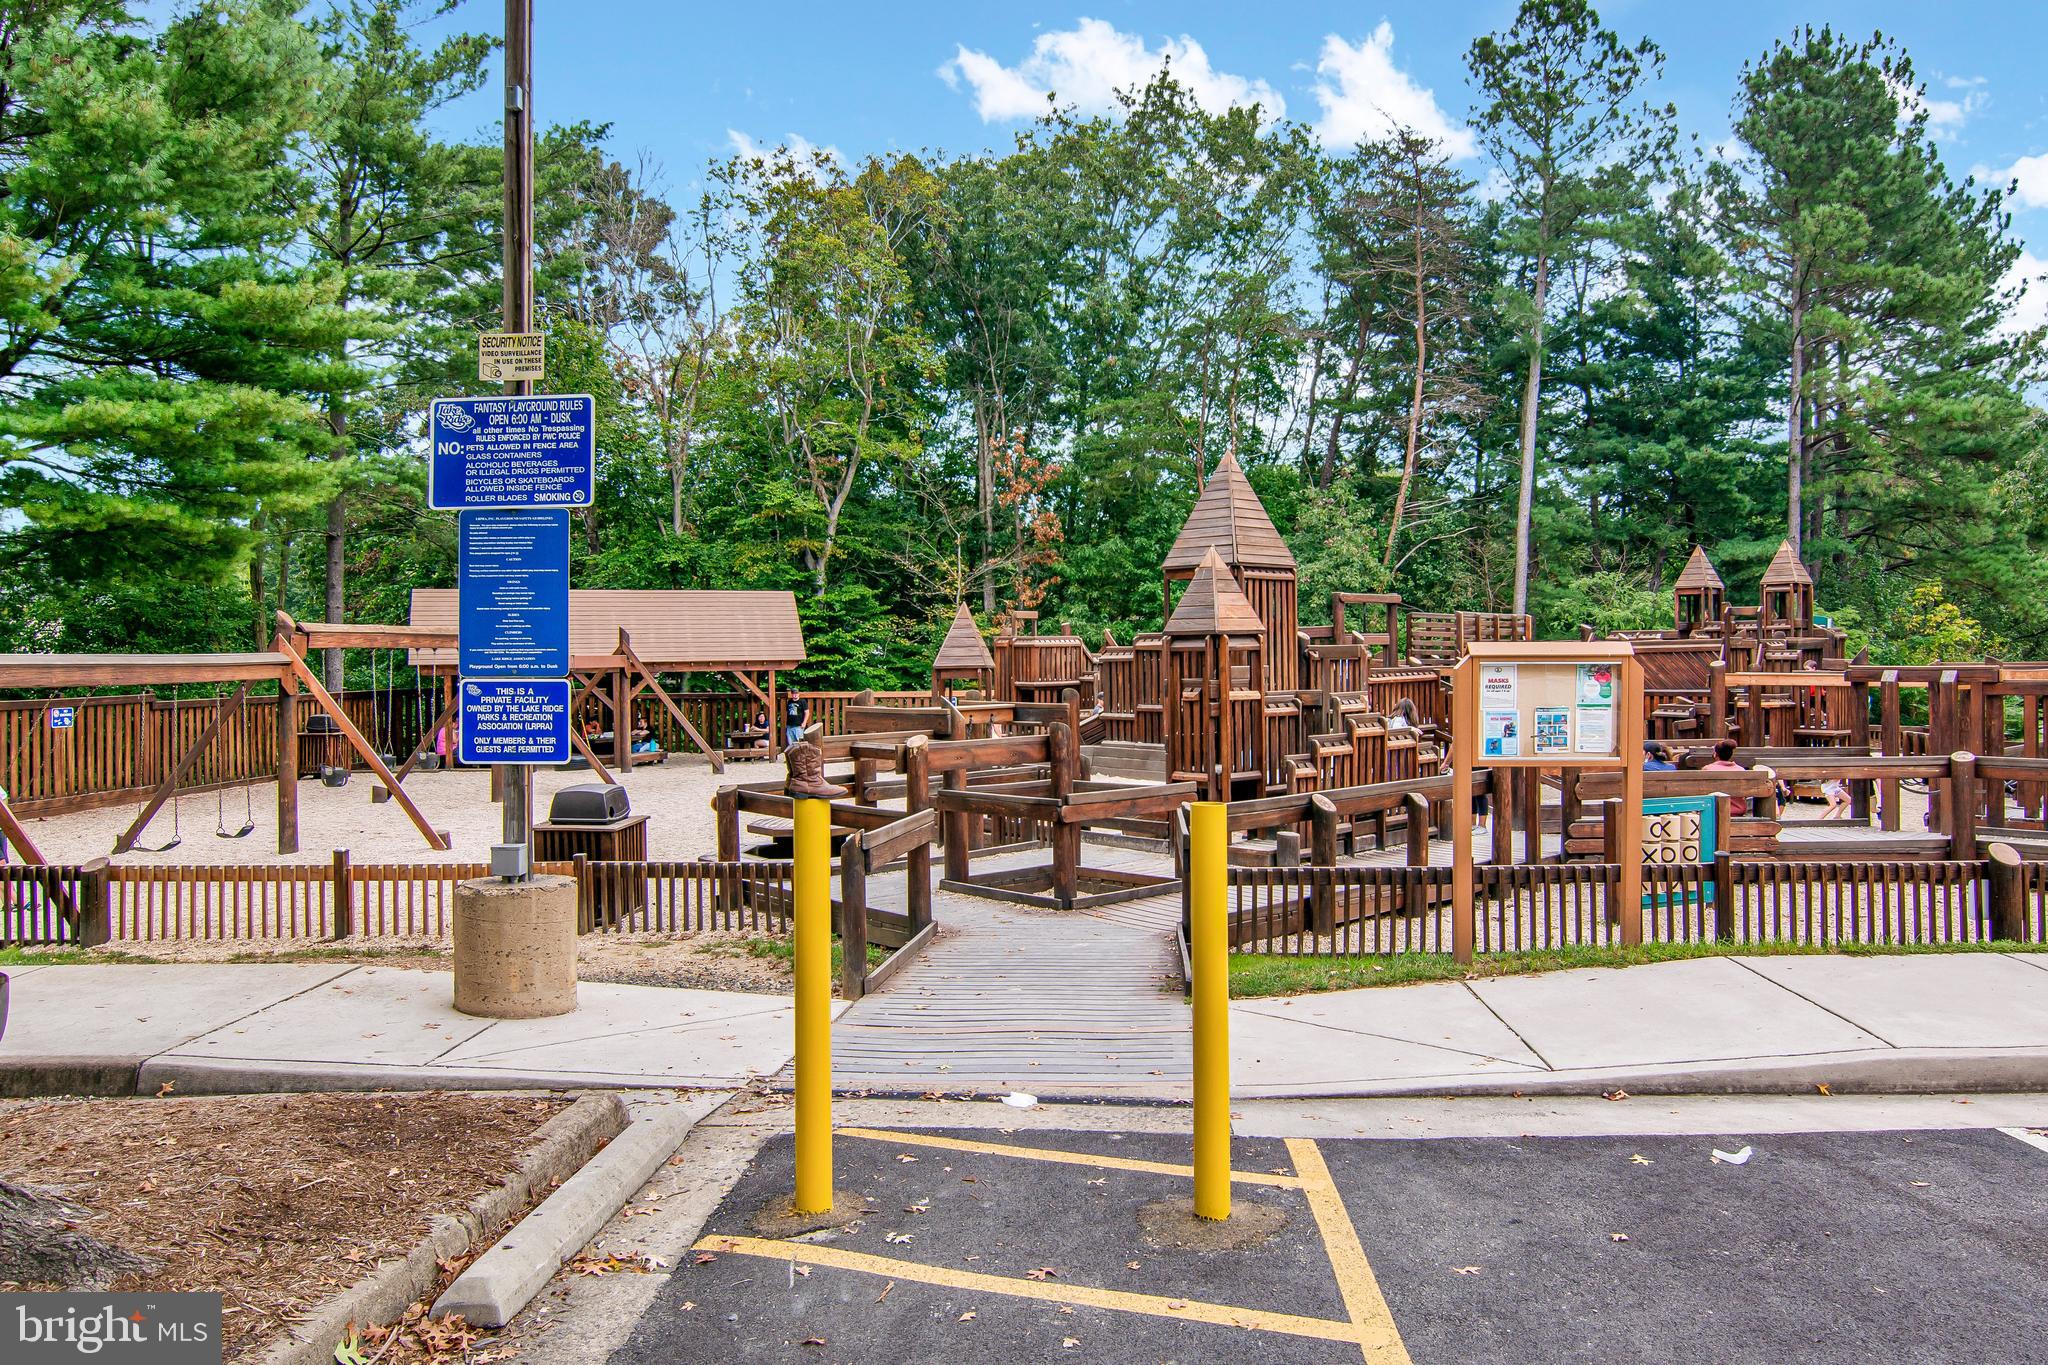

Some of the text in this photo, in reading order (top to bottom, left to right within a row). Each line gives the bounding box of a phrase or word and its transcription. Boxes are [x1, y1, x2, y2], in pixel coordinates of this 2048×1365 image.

[482, 336, 541, 348] SECURITY NOTICE
[438, 404, 462, 416] Lake
[474, 400, 583, 413] FANTASY PLAYGROUND RULES
[443, 415, 472, 428] Ridge
[489, 415, 508, 425] OPEN
[512, 414, 528, 424] 6:00
[530, 414, 541, 424] AM
[551, 413, 571, 423] DUSK
[438, 442, 464, 455] NO:
[534, 493, 570, 502] SMOKING
[525, 722, 553, 731] (LRPRA)
